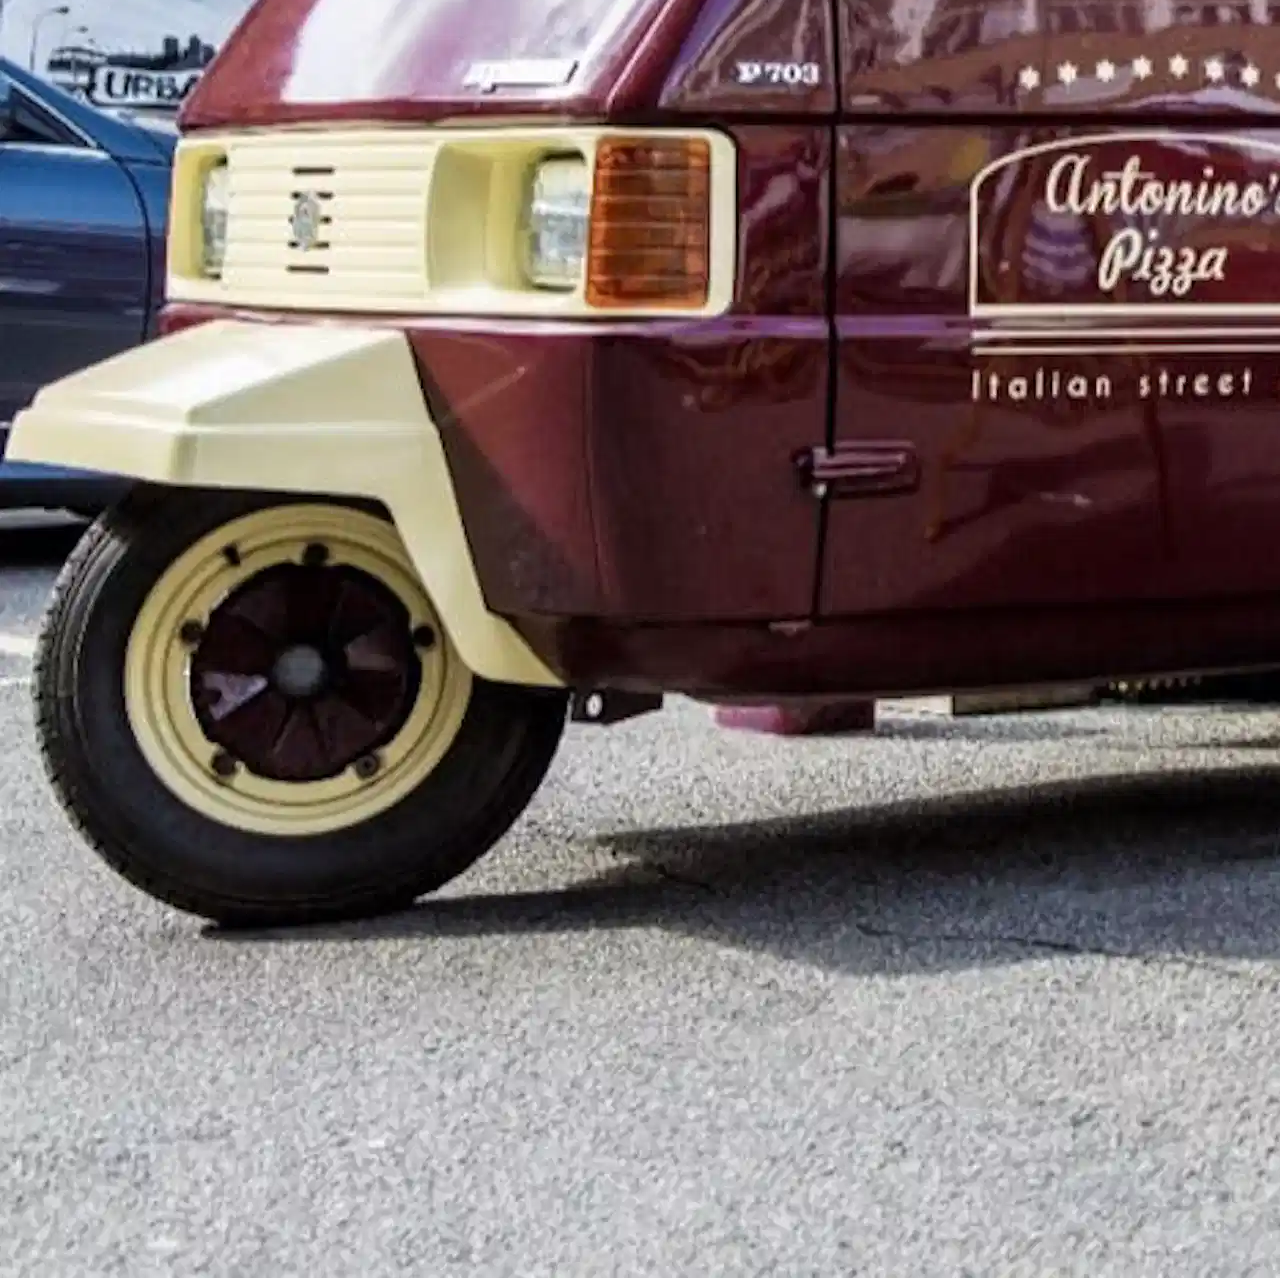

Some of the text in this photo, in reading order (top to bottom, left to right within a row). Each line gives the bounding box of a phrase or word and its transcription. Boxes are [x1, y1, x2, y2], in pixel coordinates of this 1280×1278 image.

[1098, 226, 1228, 296] Pizza
[971, 366, 1112, 403] Italian
[1138, 367, 1253, 399] street
